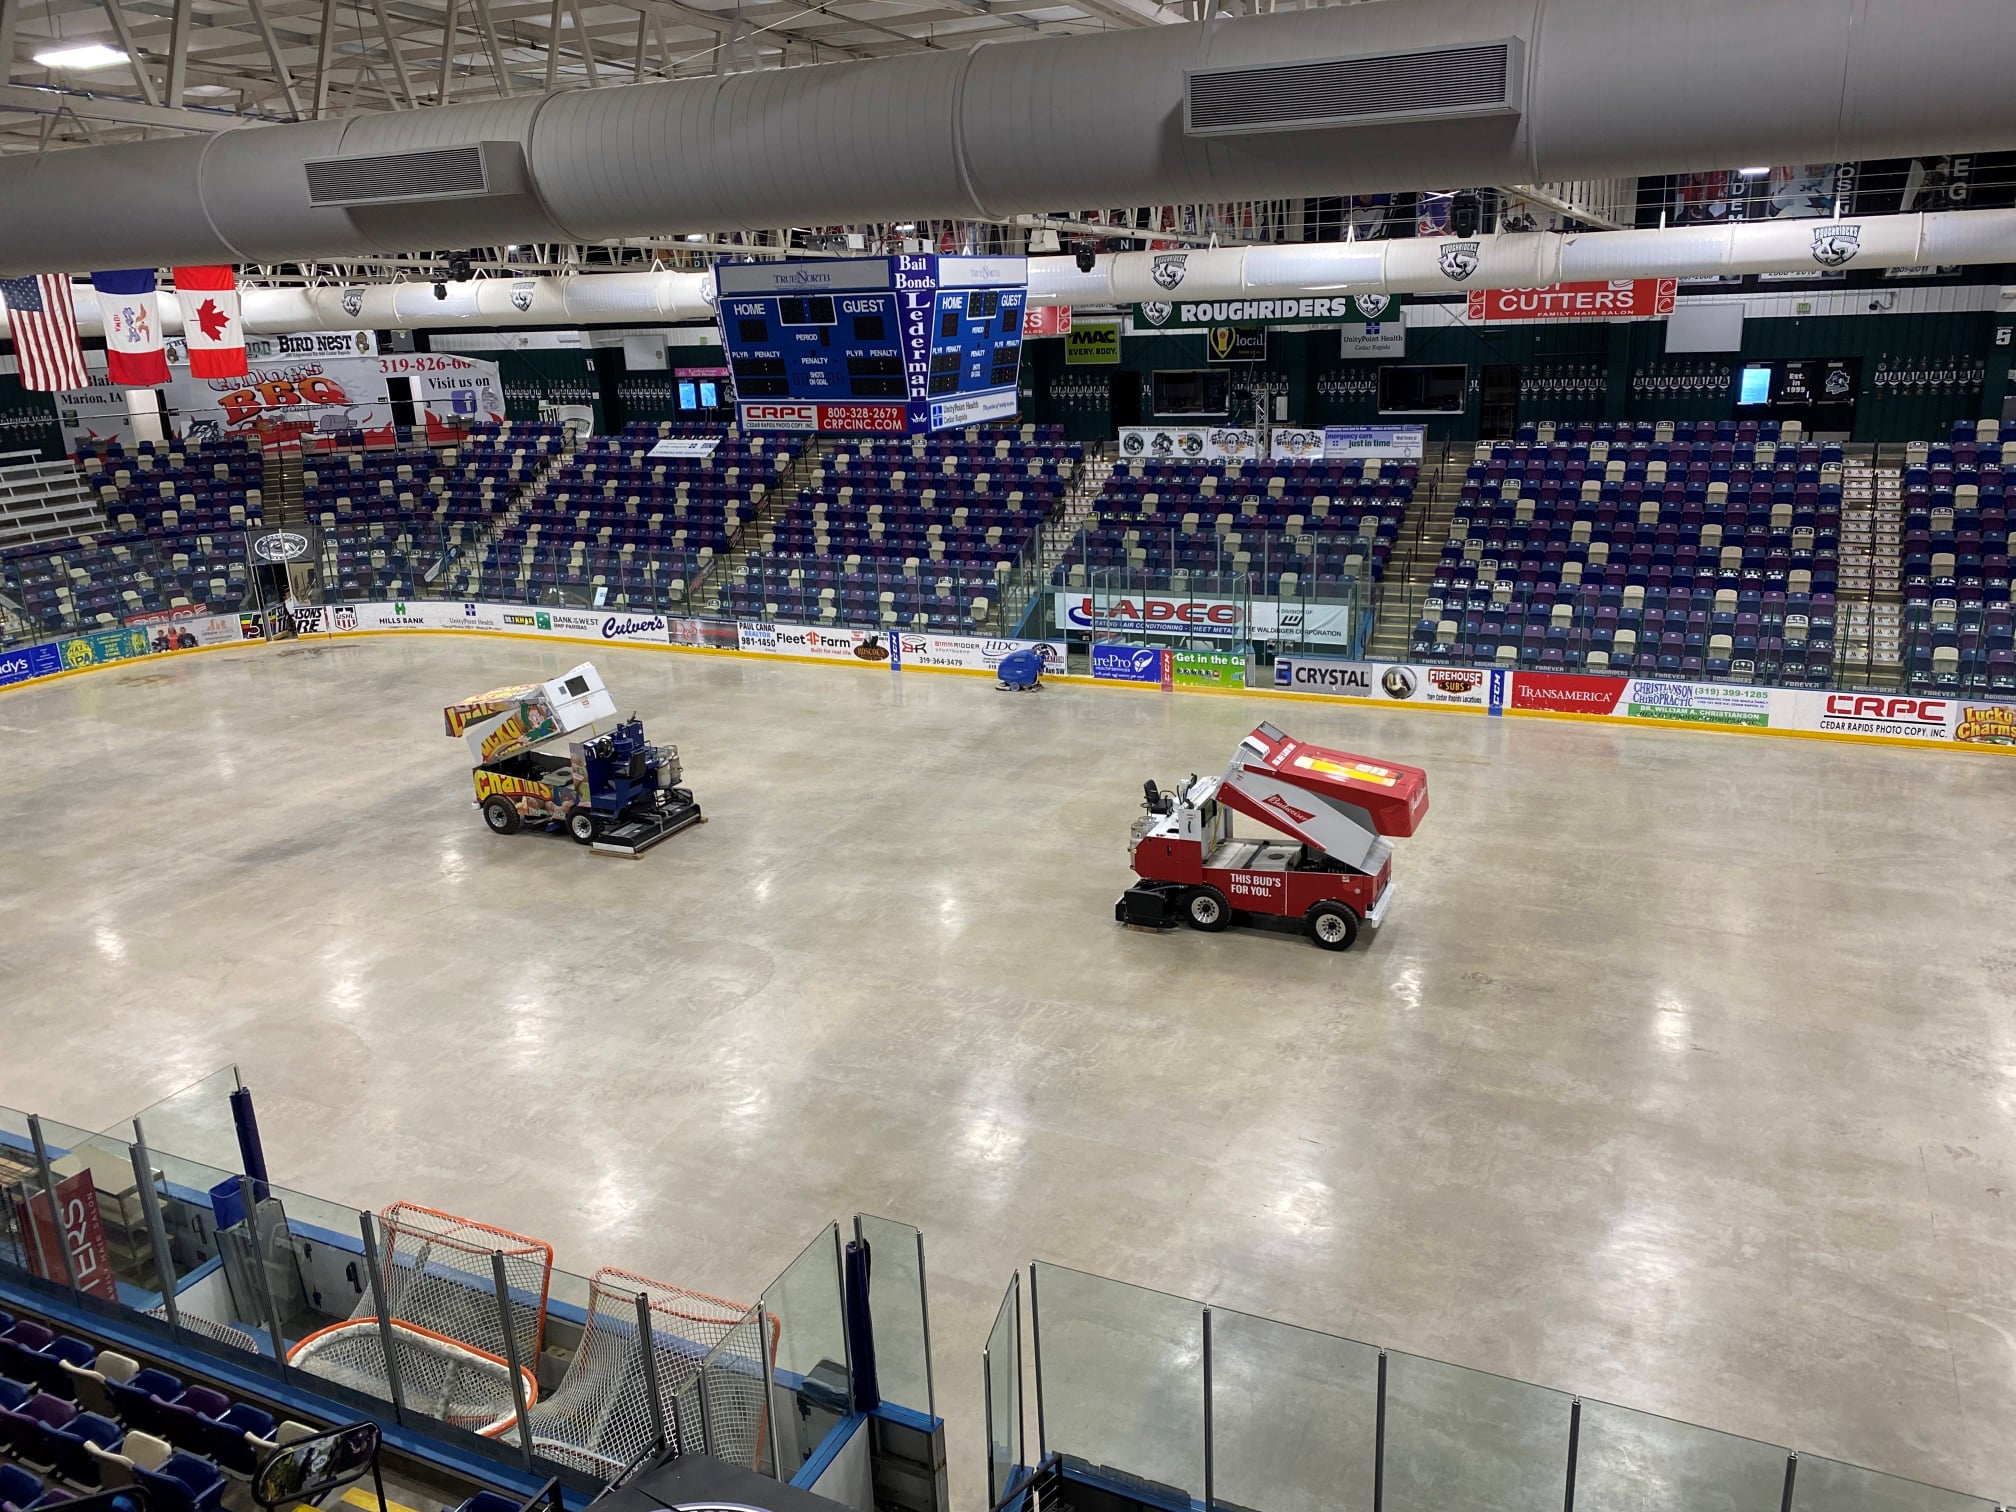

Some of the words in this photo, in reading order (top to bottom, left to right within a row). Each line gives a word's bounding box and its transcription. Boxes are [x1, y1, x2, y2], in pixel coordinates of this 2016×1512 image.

[899, 255, 927, 271] Bail
[894, 273, 936, 289] Bonds
[842, 300, 885, 313] GUEST
[942, 296, 963, 310] HOME
[1001, 294, 1022, 307] GUEST
[1499, 291, 1634, 311] CUTTERS
[734, 303, 766, 316] HOME
[1180, 297, 1346, 323] ROUGHRIDERS
[972, 326, 984, 334] PERIOD
[1072, 330, 1115, 344] MAC
[276, 335, 314, 353] BIRD
[905, 292, 931, 398] Lederman
[1236, 334, 1263, 346] local
[1344, 335, 1379, 344] UnityPoint
[1380, 334, 1403, 342] Health
[732, 351, 749, 359] PLYR
[846, 349, 864, 357] PLYR
[869, 348, 898, 357] PENALTY
[801, 357, 829, 365] PENALTY
[428, 376, 456, 390] Visit
[460, 378, 472, 388] us
[476, 377, 490, 387] on
[60, 394, 106, 406] Marion,
[109, 392, 123, 403] IA
[218, 376, 353, 426] BBQ
[746, 406, 813, 420] CRPC
[827, 407, 898, 419] 800-328-2679
[823, 418, 902, 430] CRPCINC.COM
[1348, 440, 1364, 448] just
[1081, 598, 1244, 624] LADCO
[578, 617, 599, 626] WEST
[602, 616, 664, 639] Culver's
[740, 622, 754, 631] PAUL
[756, 624, 776, 632] CANAS
[744, 630, 771, 638] REALTOR
[776, 632, 806, 644] Fleet
[820, 636, 851, 648] Farm
[742, 637, 776, 648] 981-1450
[986, 640, 1018, 651] HDC
[919, 656, 963, 666] 319-364-3479
[1176, 653, 1194, 664] Get
[1198, 654, 1208, 664] in
[1210, 654, 1228, 665] the
[1295, 666, 1370, 688] CRYSTAL
[1430, 671, 1482, 688] FIREHOUSE
[1445, 682, 1465, 691] SUBS
[1518, 684, 1611, 702] TRANSAMERICA
[1634, 682, 1694, 698] CHRISTIANSON
[1694, 687, 1720, 696] (319)
[1722, 688, 1769, 699] 399-1285
[1632, 692, 1694, 707] CHIROPRACTIC
[1700, 710, 1760, 720] CHRISTIANSON
[1826, 695, 1946, 721] CRPC
[1964, 706, 2014, 725] Lucky
[1820, 720, 1846, 730] CEDAR
[1848, 722, 1874, 733] RAPIDS
[1876, 725, 1902, 736] PHOTO
[1904, 727, 1928, 738] COPY,
[1930, 729, 1948, 738] INC.
[1230, 873, 1252, 884] THIS
[1252, 876, 1282, 887] BUD'S
[1230, 884, 1248, 895] FOR
[1250, 886, 1272, 898] YOU.
